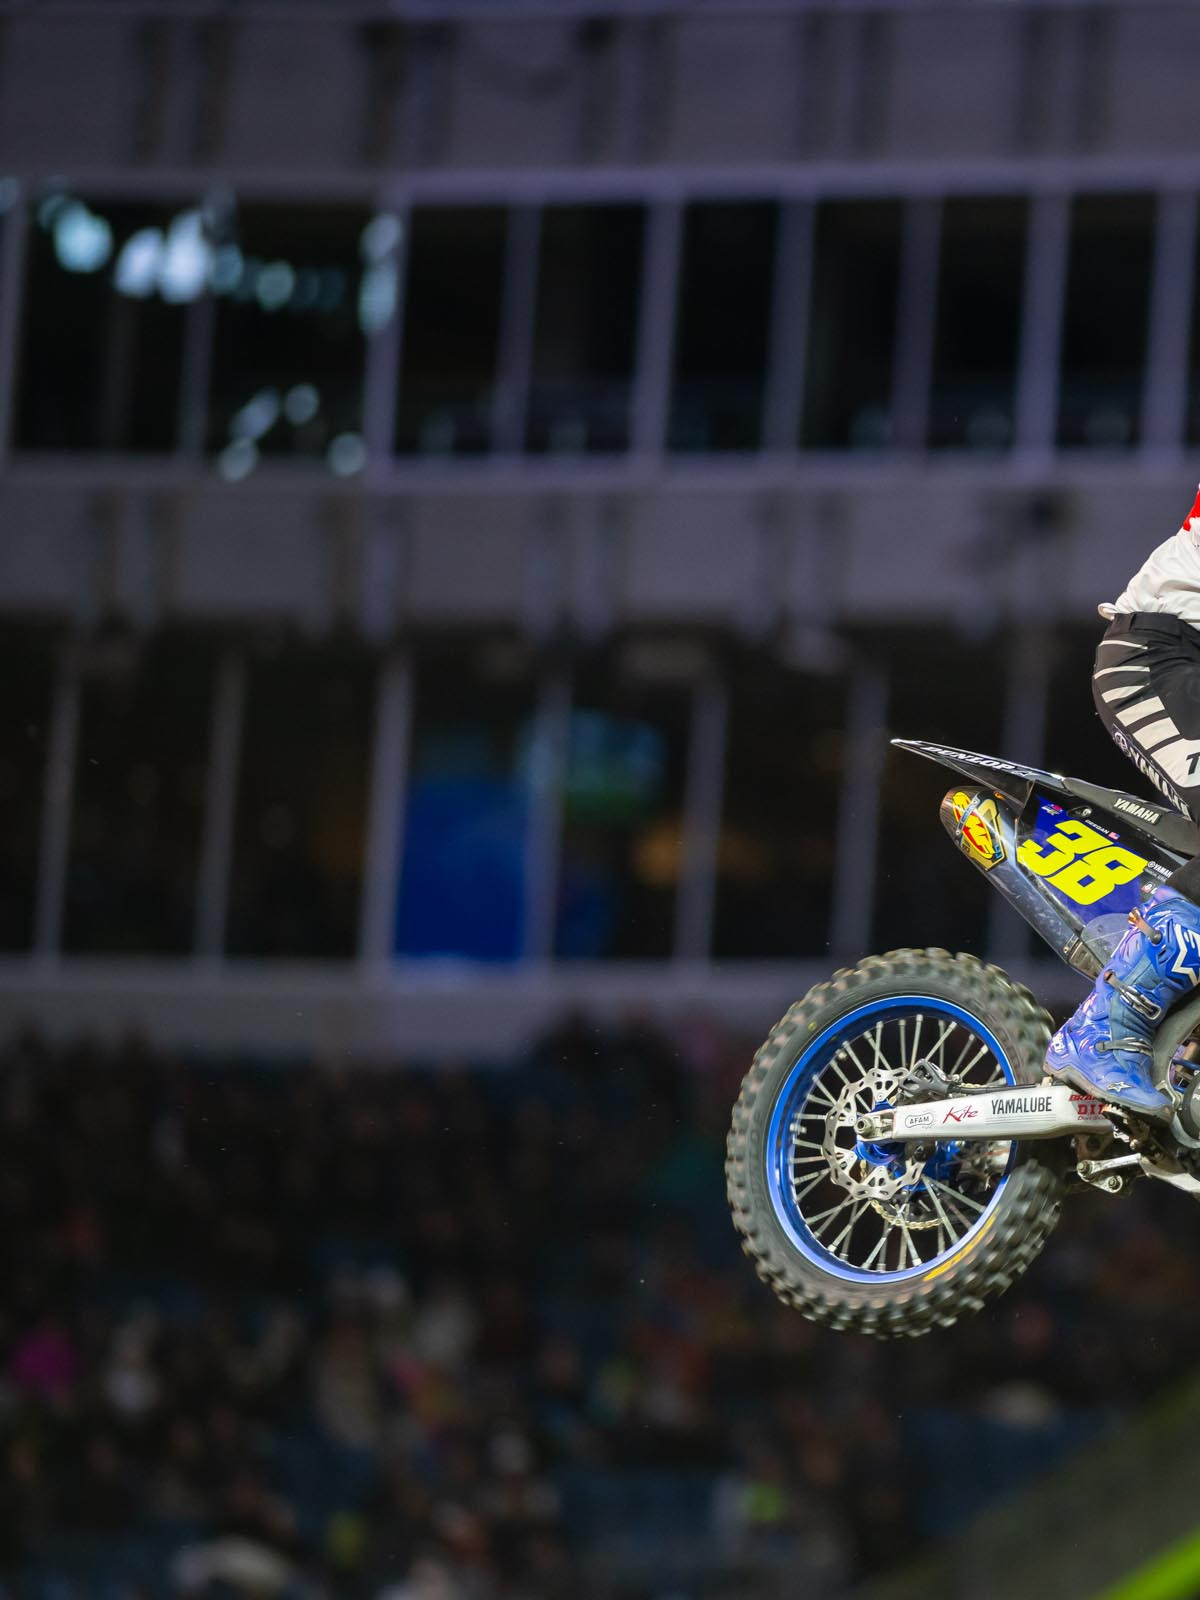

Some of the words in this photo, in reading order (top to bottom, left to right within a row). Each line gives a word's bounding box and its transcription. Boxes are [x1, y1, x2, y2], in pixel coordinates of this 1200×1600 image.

[920, 746, 1015, 770] DUNLOP
[1113, 798, 1160, 824] YAMAHA
[1016, 820, 1149, 905] 38
[1153, 863, 1174, 878] YAMAH
[942, 1104, 979, 1125] Kite
[991, 1096, 1052, 1115] YAMALUBE
[909, 1115, 930, 1125] AFAM
